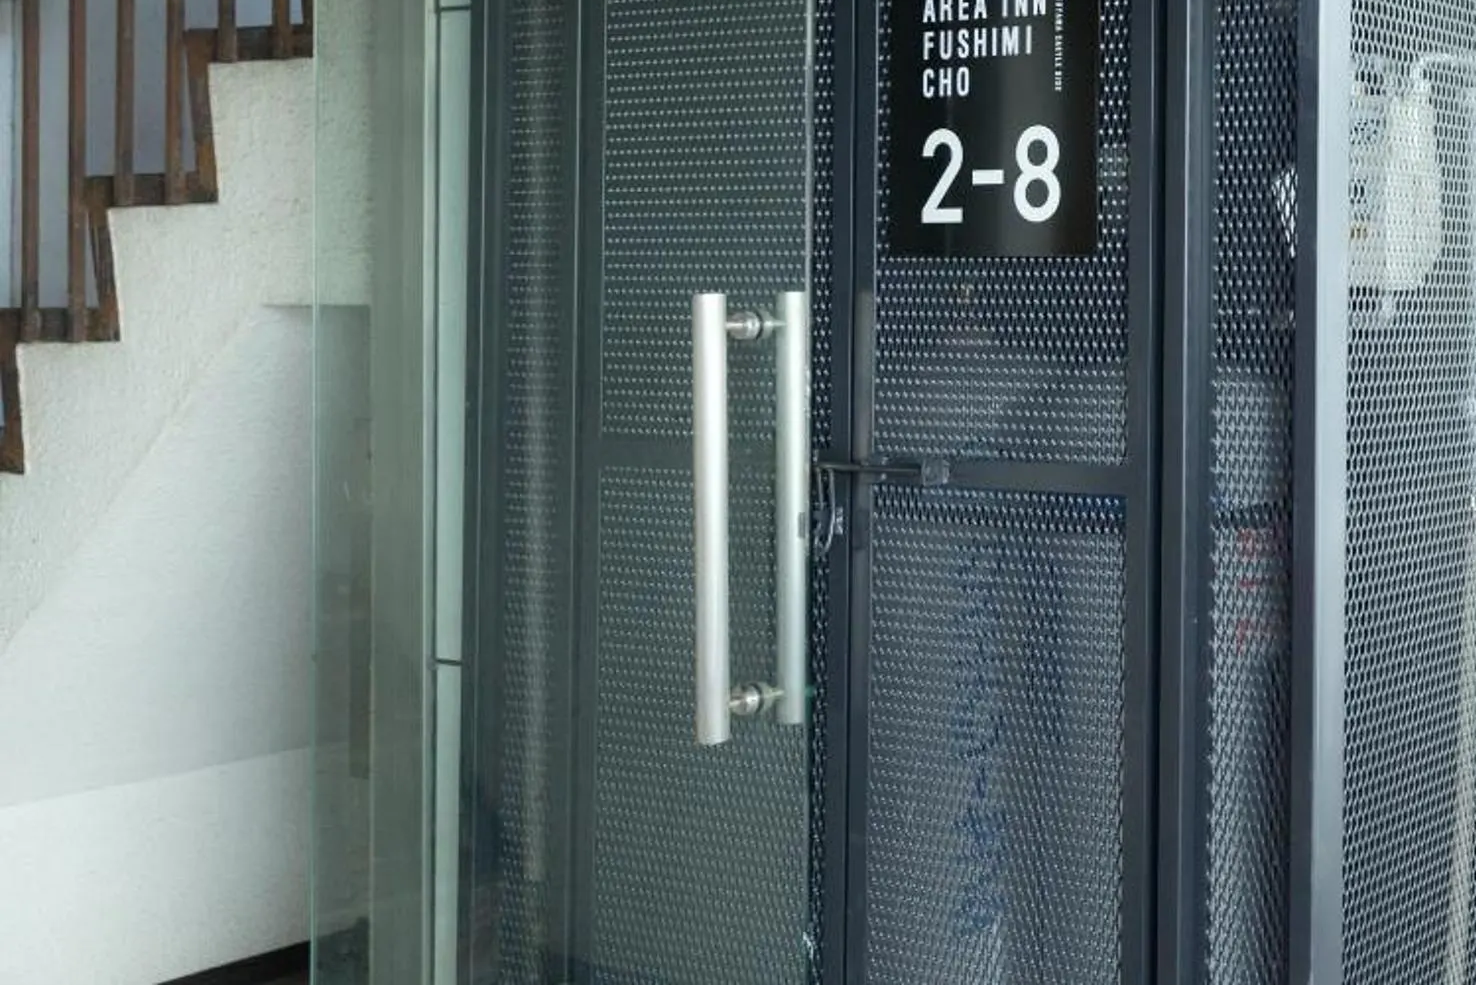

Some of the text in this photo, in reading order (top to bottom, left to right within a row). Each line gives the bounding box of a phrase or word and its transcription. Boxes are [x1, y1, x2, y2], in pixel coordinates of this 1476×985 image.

[922, 25, 1033, 61] FUSHIMI
[922, 66, 971, 98] CHO
[921, 124, 1062, 224] 2-8
